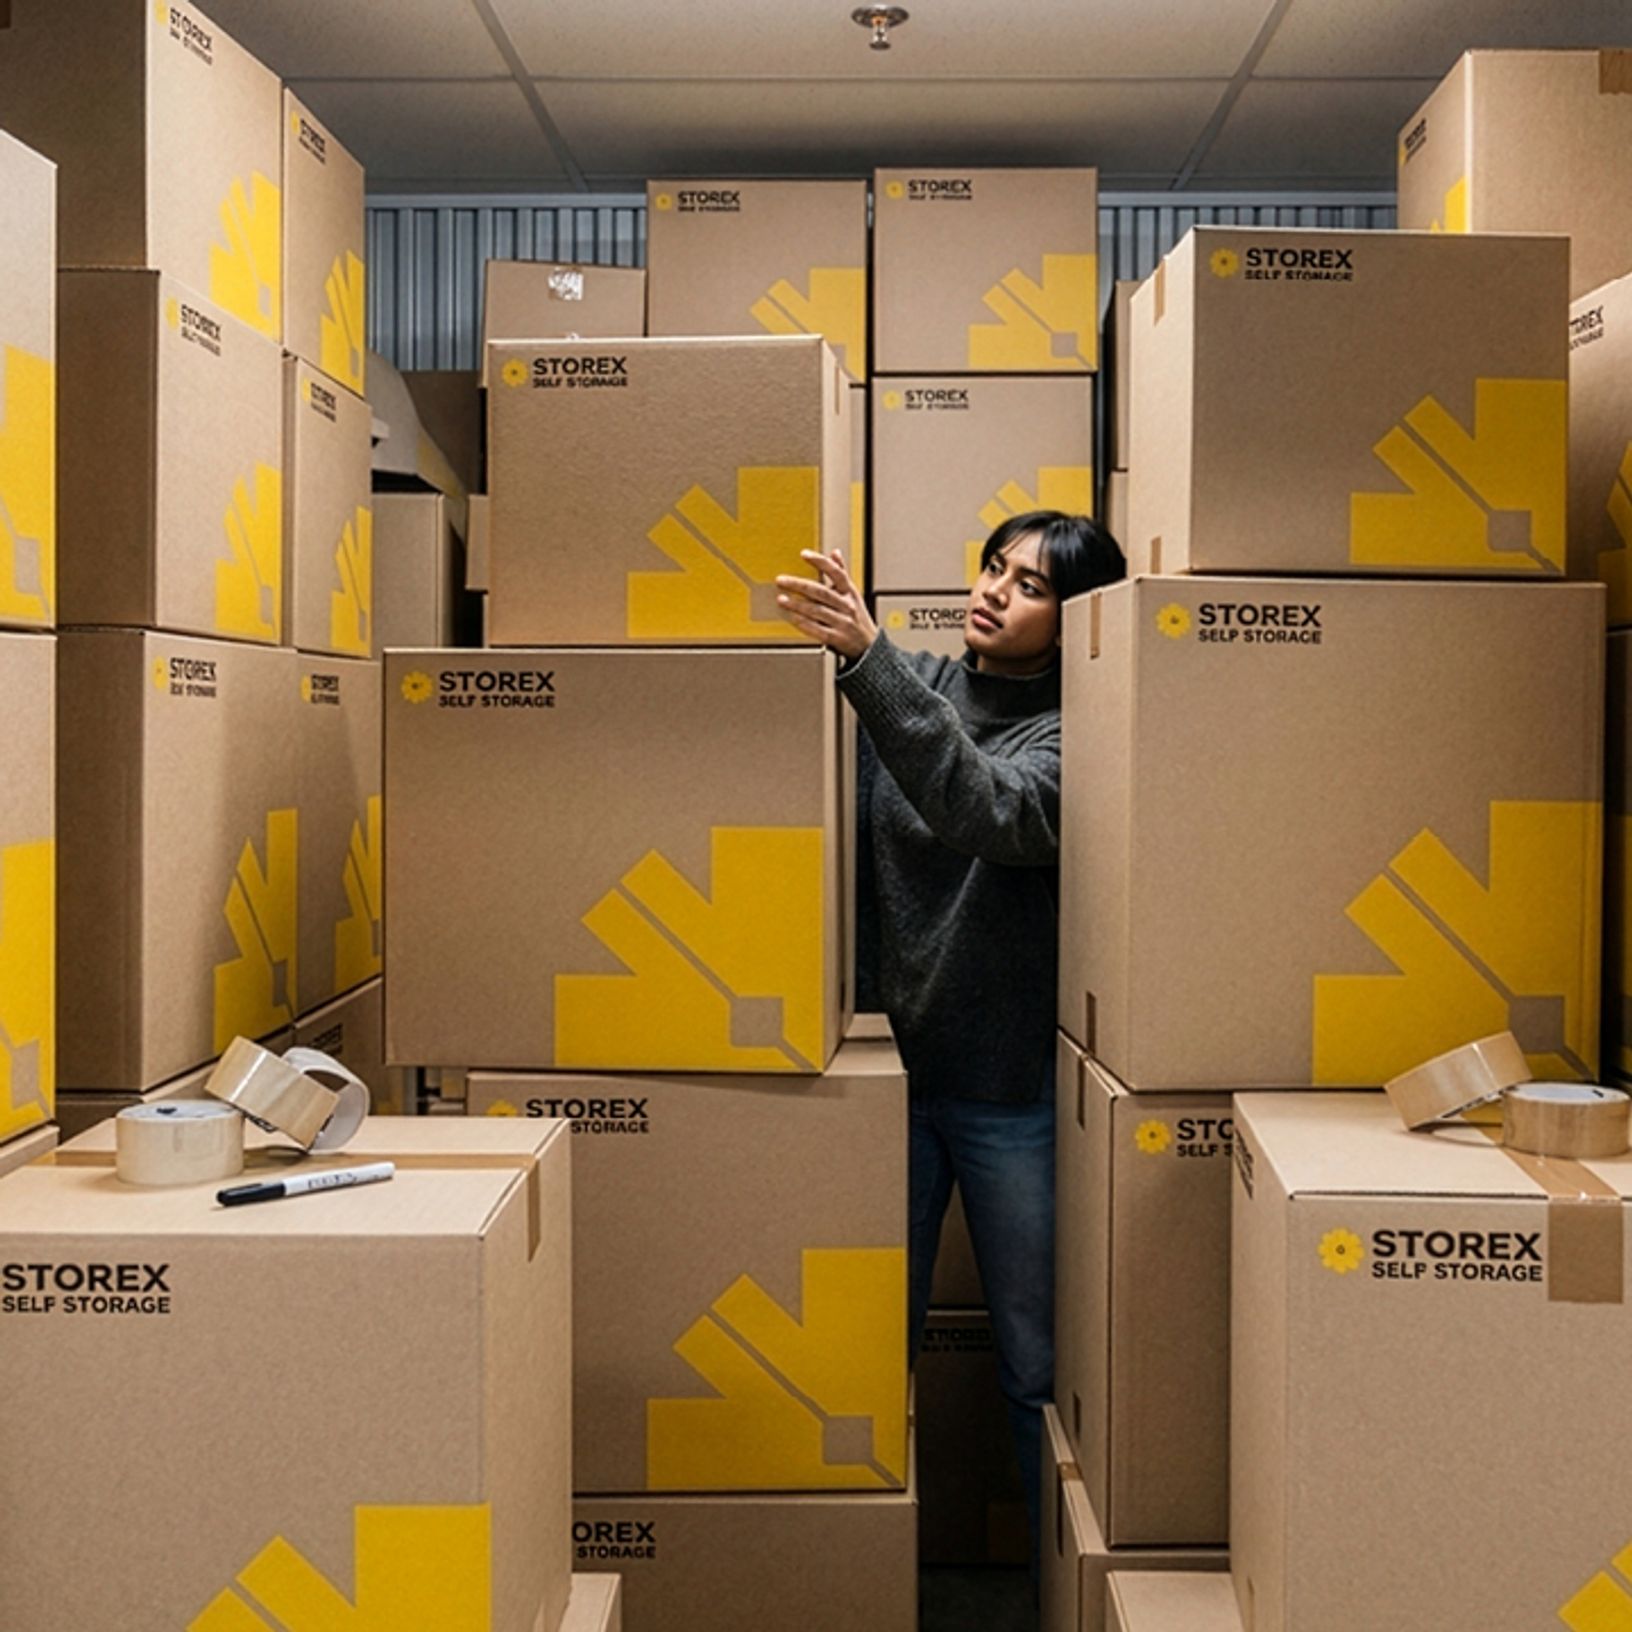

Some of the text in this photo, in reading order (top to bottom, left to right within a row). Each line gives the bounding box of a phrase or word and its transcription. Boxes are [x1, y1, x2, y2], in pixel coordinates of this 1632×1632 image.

[1246, 247, 1353, 269] STOREX
[533, 356, 627, 375] STOREX
[905, 389, 968, 403] STOREX
[1199, 603, 1322, 627] STOREX
[439, 671, 555, 692] STOREX
[480, 694, 555, 708] STORAGE
[525, 1098, 649, 1119] STOREX
[570, 1121, 649, 1134] STORAGE
[1177, 1118, 1233, 1141] STO
[1177, 1143, 1218, 1158] SELF
[1372, 1229, 1543, 1262] STOREX
[2, 1263, 170, 1292] STOREX
[1434, 1262, 1543, 1283] STORAGE
[2, 1295, 170, 1314] SELF STORAGE
[572, 1520, 656, 1543] OREX
[577, 1545, 656, 1559] STORAGE
